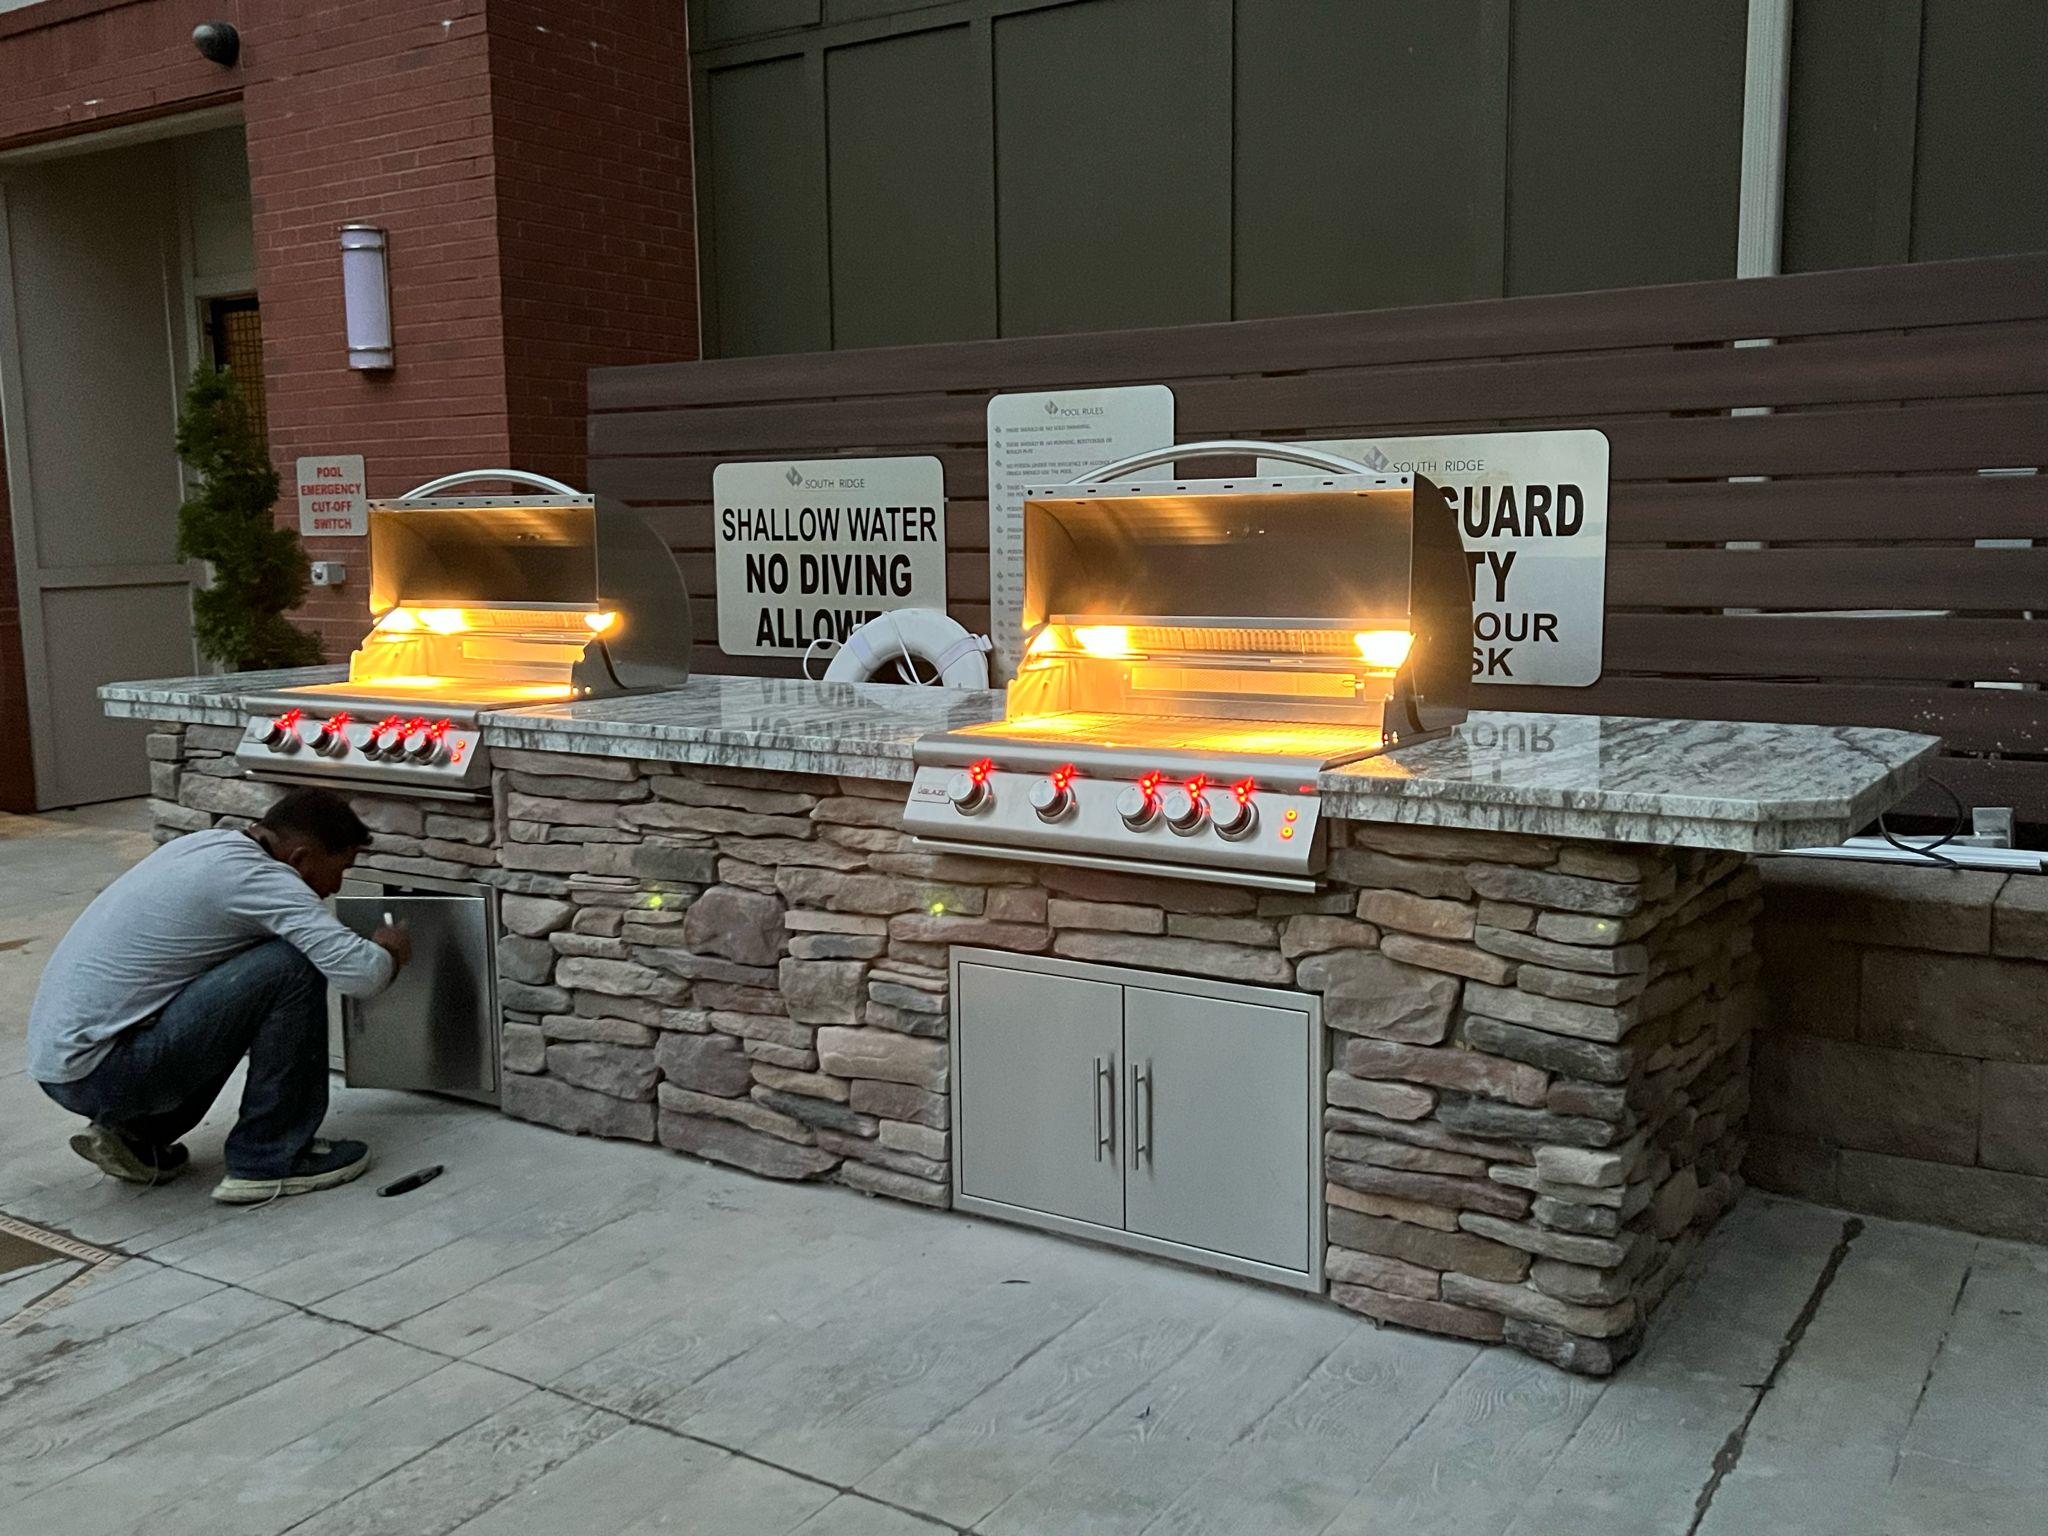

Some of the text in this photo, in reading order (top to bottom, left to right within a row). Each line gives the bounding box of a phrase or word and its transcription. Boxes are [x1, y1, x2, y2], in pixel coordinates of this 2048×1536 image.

[1060, 406, 1104, 417] POOL RULES
[1393, 459, 1485, 473] SOUTH RIDGE
[317, 467, 343, 478] POOL
[805, 478, 865, 489] SOUTH RIDGE
[301, 484, 361, 496] EMERGENCY
[312, 502, 352, 512] CUT-OFF
[314, 519, 352, 530] SWITCH
[722, 507, 937, 542] SHALLOW WATER
[746, 553, 912, 597] NO DIVING
[1473, 612, 1559, 643] OUR
